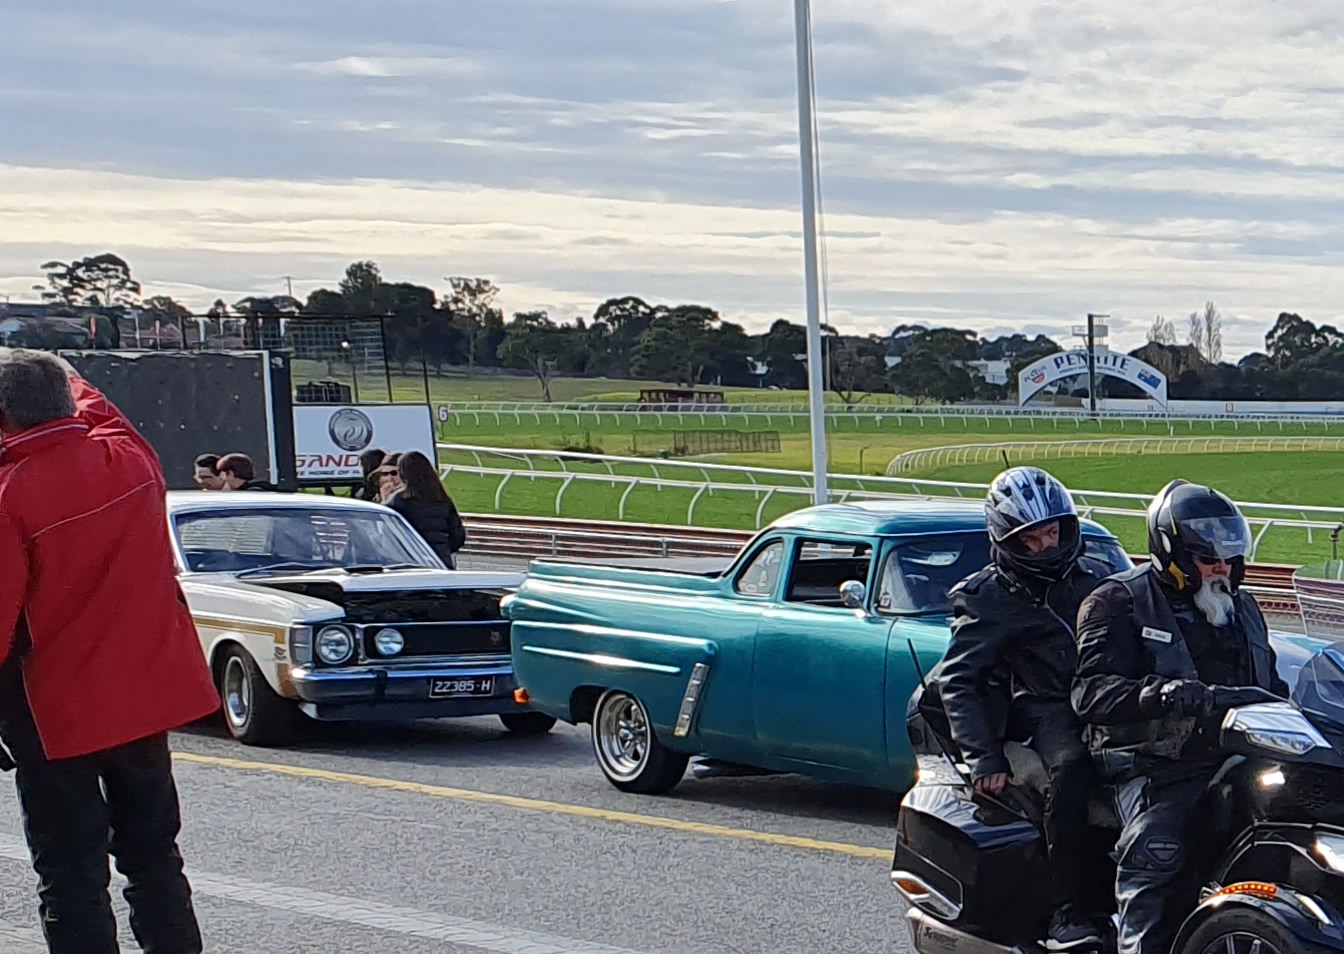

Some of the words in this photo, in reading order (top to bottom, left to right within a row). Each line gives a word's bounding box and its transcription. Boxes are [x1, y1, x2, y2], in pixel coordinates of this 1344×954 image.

[1053, 353, 1131, 371] PENITE
[439, 406, 448, 421] 6
[296, 454, 359, 468] SAND
